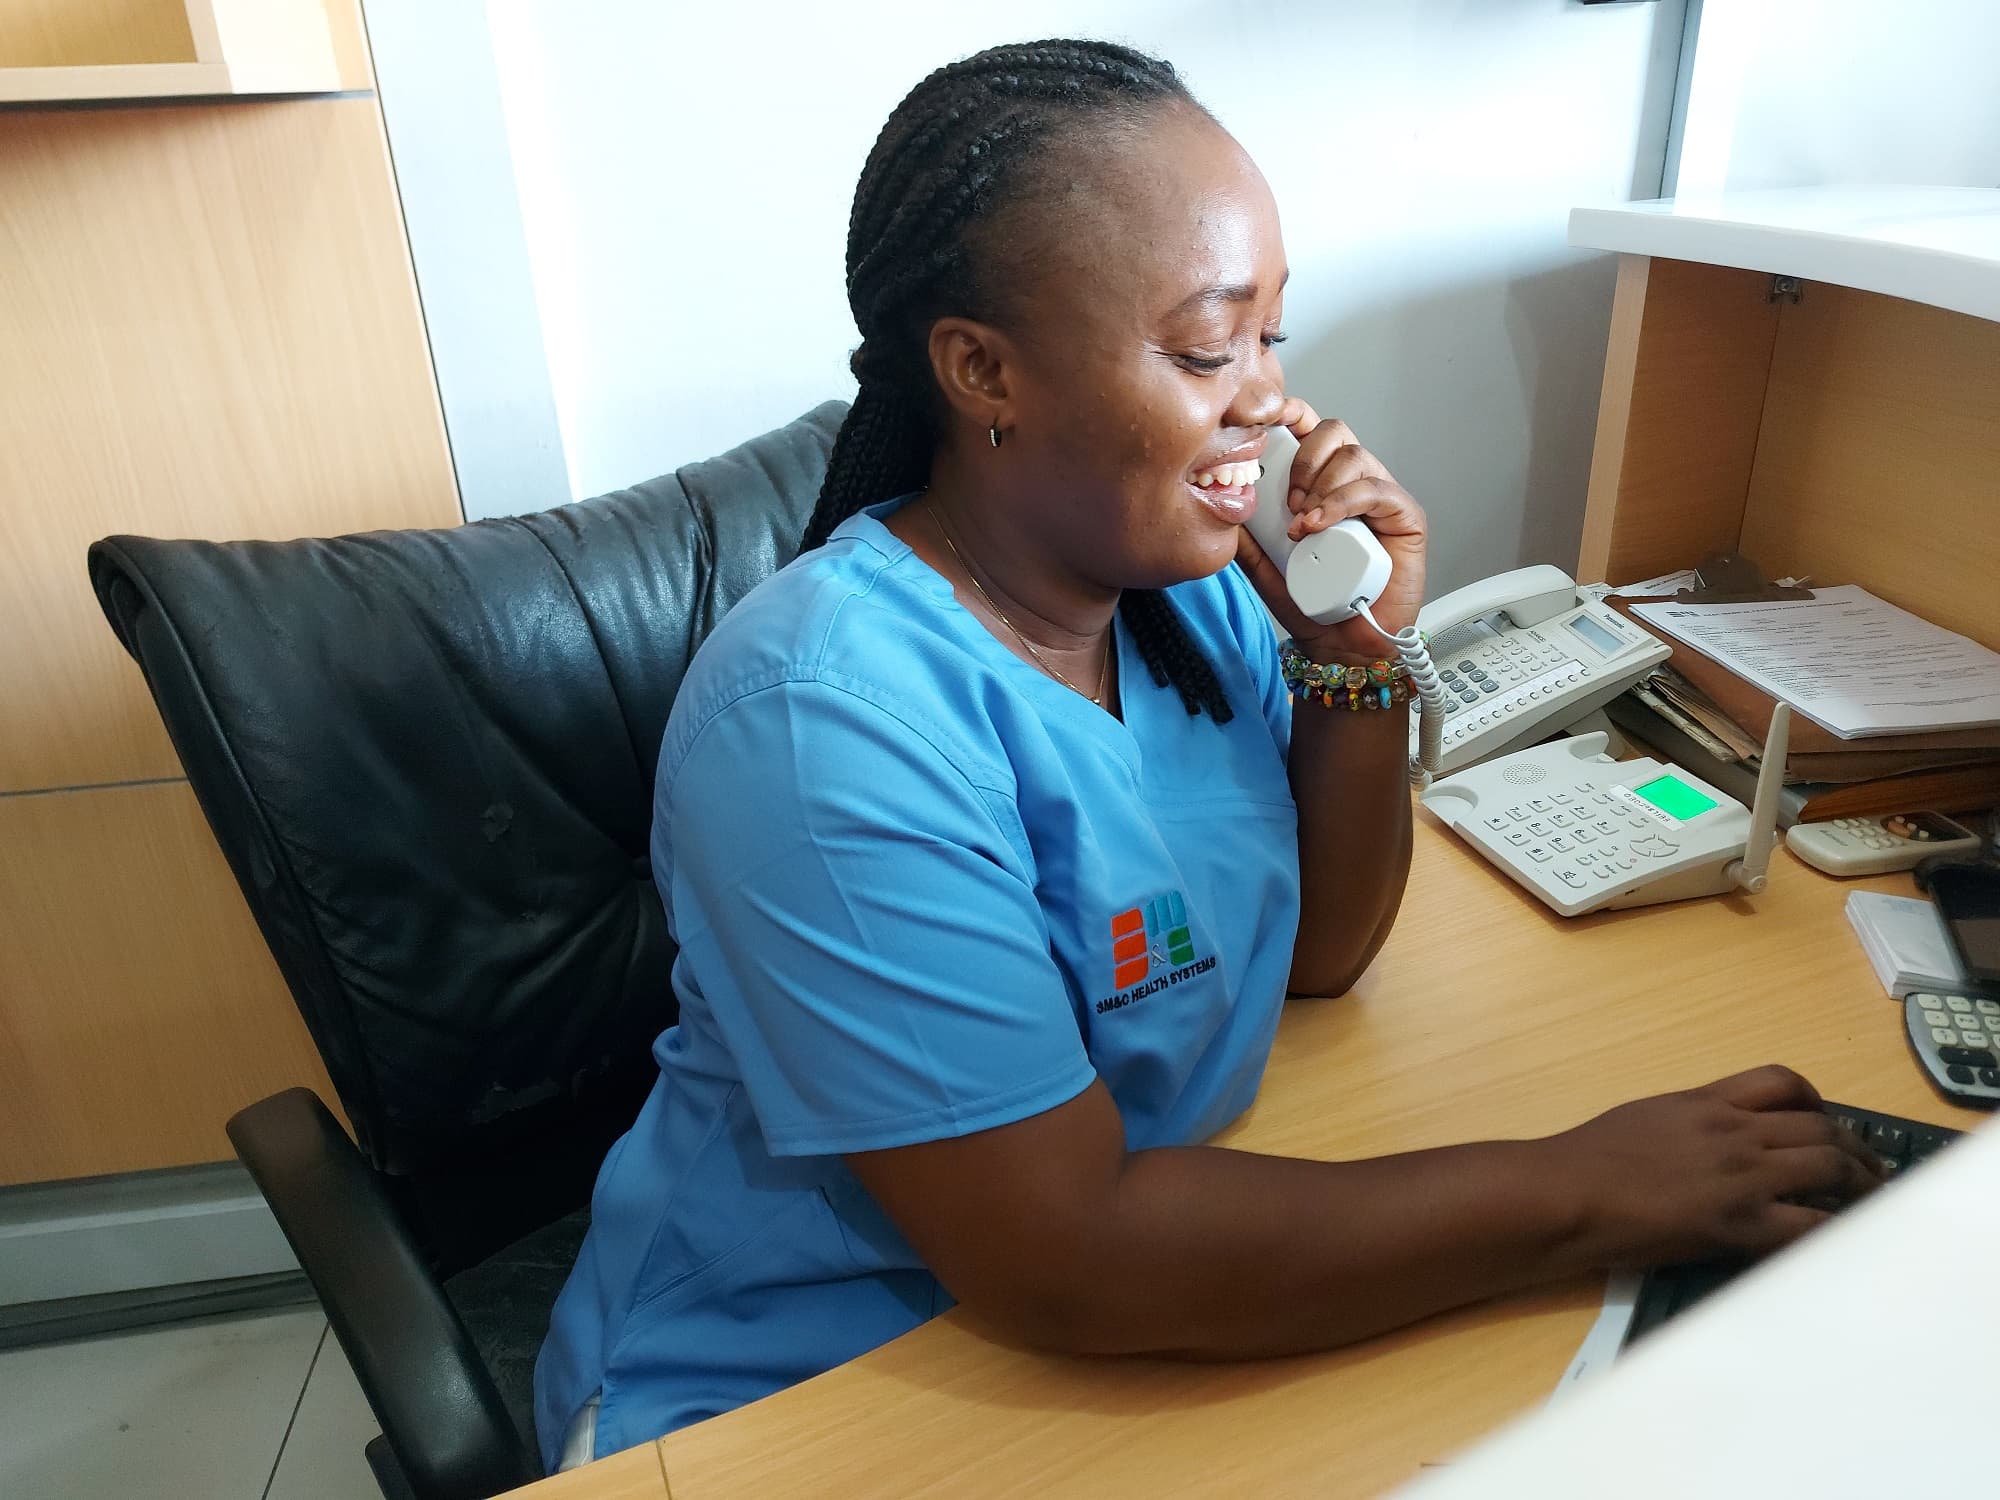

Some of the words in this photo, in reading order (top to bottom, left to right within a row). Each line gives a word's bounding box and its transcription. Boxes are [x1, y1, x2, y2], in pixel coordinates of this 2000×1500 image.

[1096, 993, 1129, 1014] 3M&C
[1131, 975, 1168, 1003] HEALTH
[1170, 957, 1216, 985] SYSTEMS
